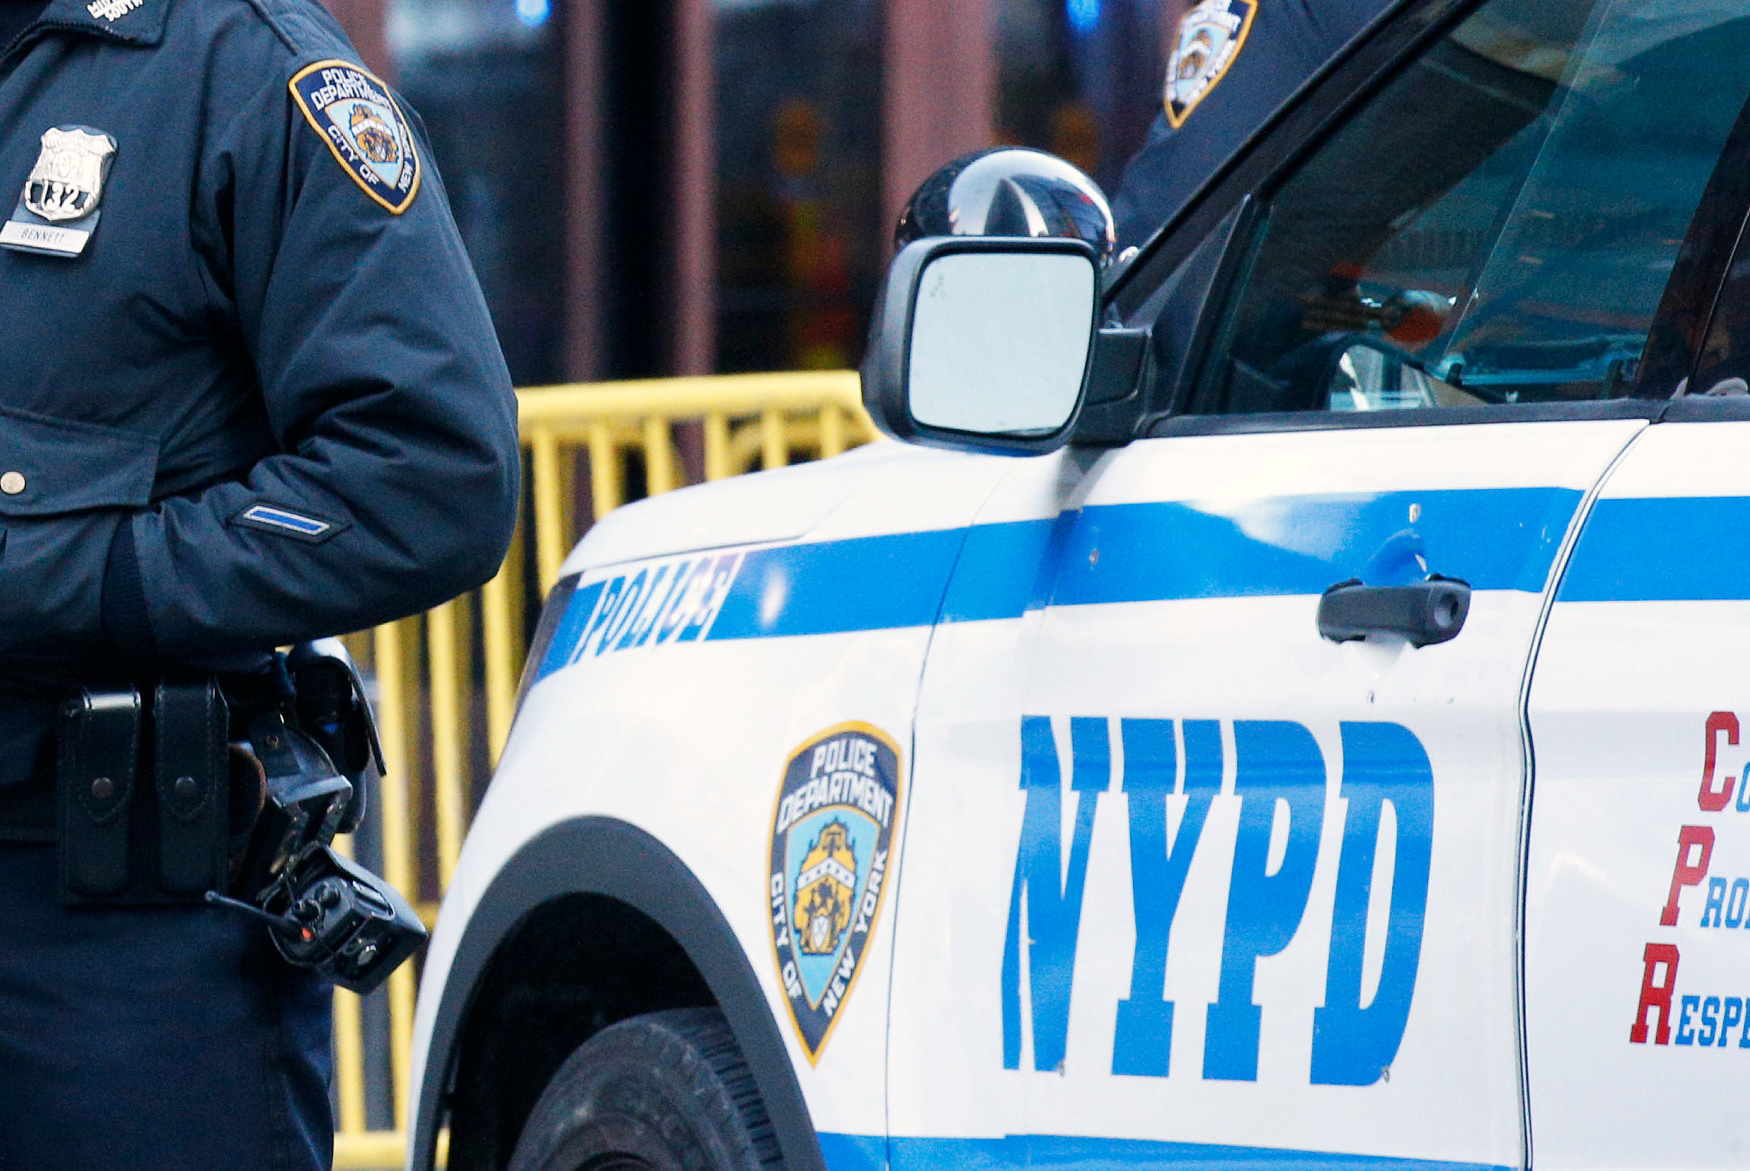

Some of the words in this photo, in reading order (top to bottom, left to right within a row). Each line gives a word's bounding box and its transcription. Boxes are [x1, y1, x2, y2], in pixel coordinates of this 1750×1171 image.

[310, 80, 393, 111] DEPARTMENT
[321, 67, 369, 87] POLICE
[327, 125, 359, 162] CITY
[359, 164, 380, 185] OF
[41, 179, 80, 211] 132
[21, 229, 66, 244] BENNETT
[810, 737, 878, 779] POLICE
[776, 770, 895, 835] DEPARTMENT
[1001, 714, 1435, 1087] NYPD
[1659, 824, 1750, 929] PRO
[771, 872, 790, 947] CITY
[782, 960, 803, 998] OF
[822, 947, 857, 1017] NEW
[854, 849, 889, 934] YORK
